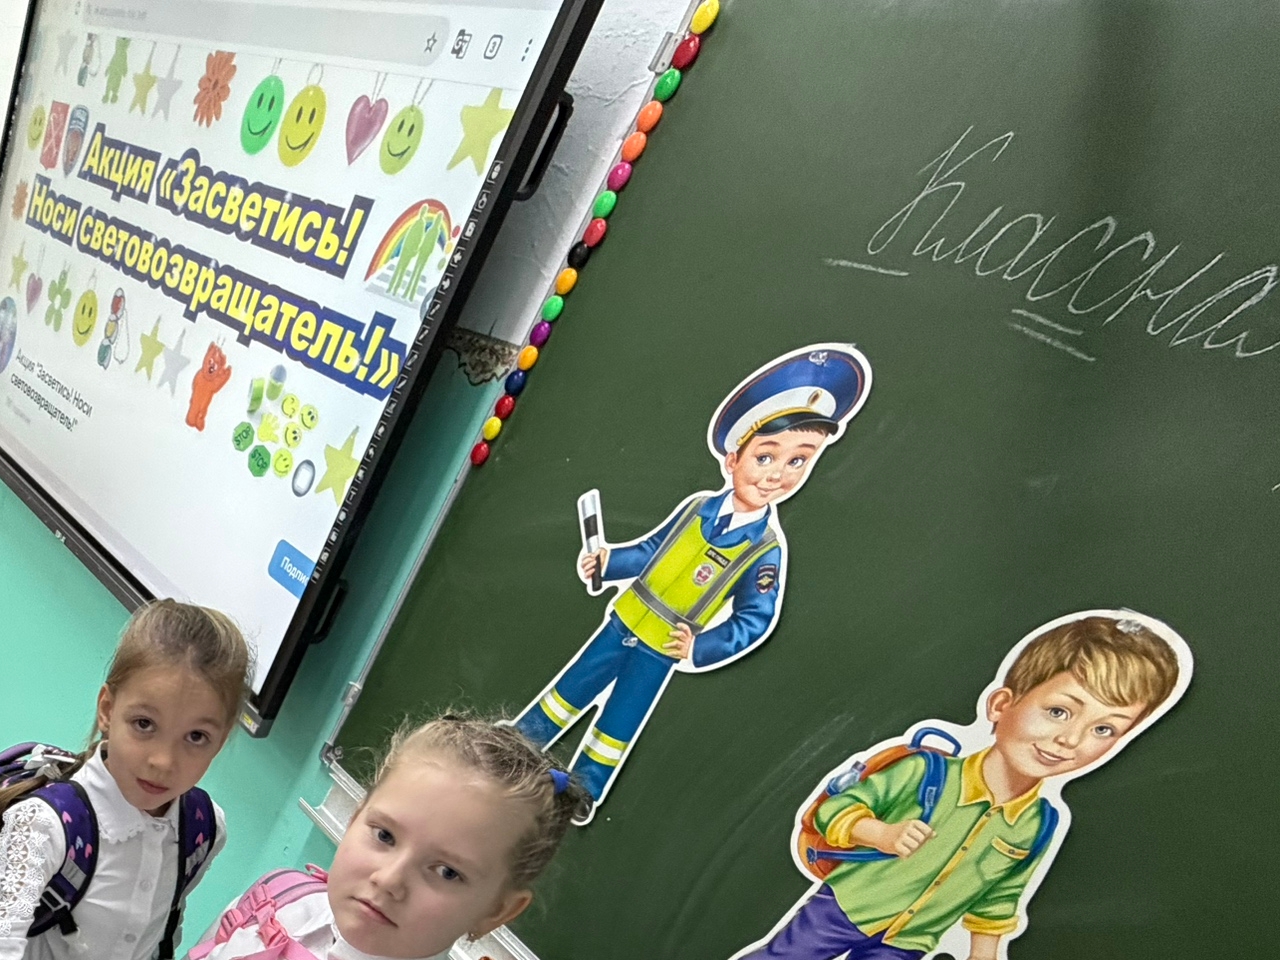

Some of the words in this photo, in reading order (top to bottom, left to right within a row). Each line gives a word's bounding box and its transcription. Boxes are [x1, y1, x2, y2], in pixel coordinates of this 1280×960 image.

[488, 41, 497, 53] 3
[81, 131, 156, 195] Акция
[158, 157, 365, 266] «Засветись!
[866, 125, 1280, 358] Классна
[29, 181, 78, 236] Носи
[78, 213, 402, 390] световозвращатель!»
[72, 390, 93, 418] Носи
[233, 426, 251, 446] STOP
[251, 448, 268, 470] STOP
